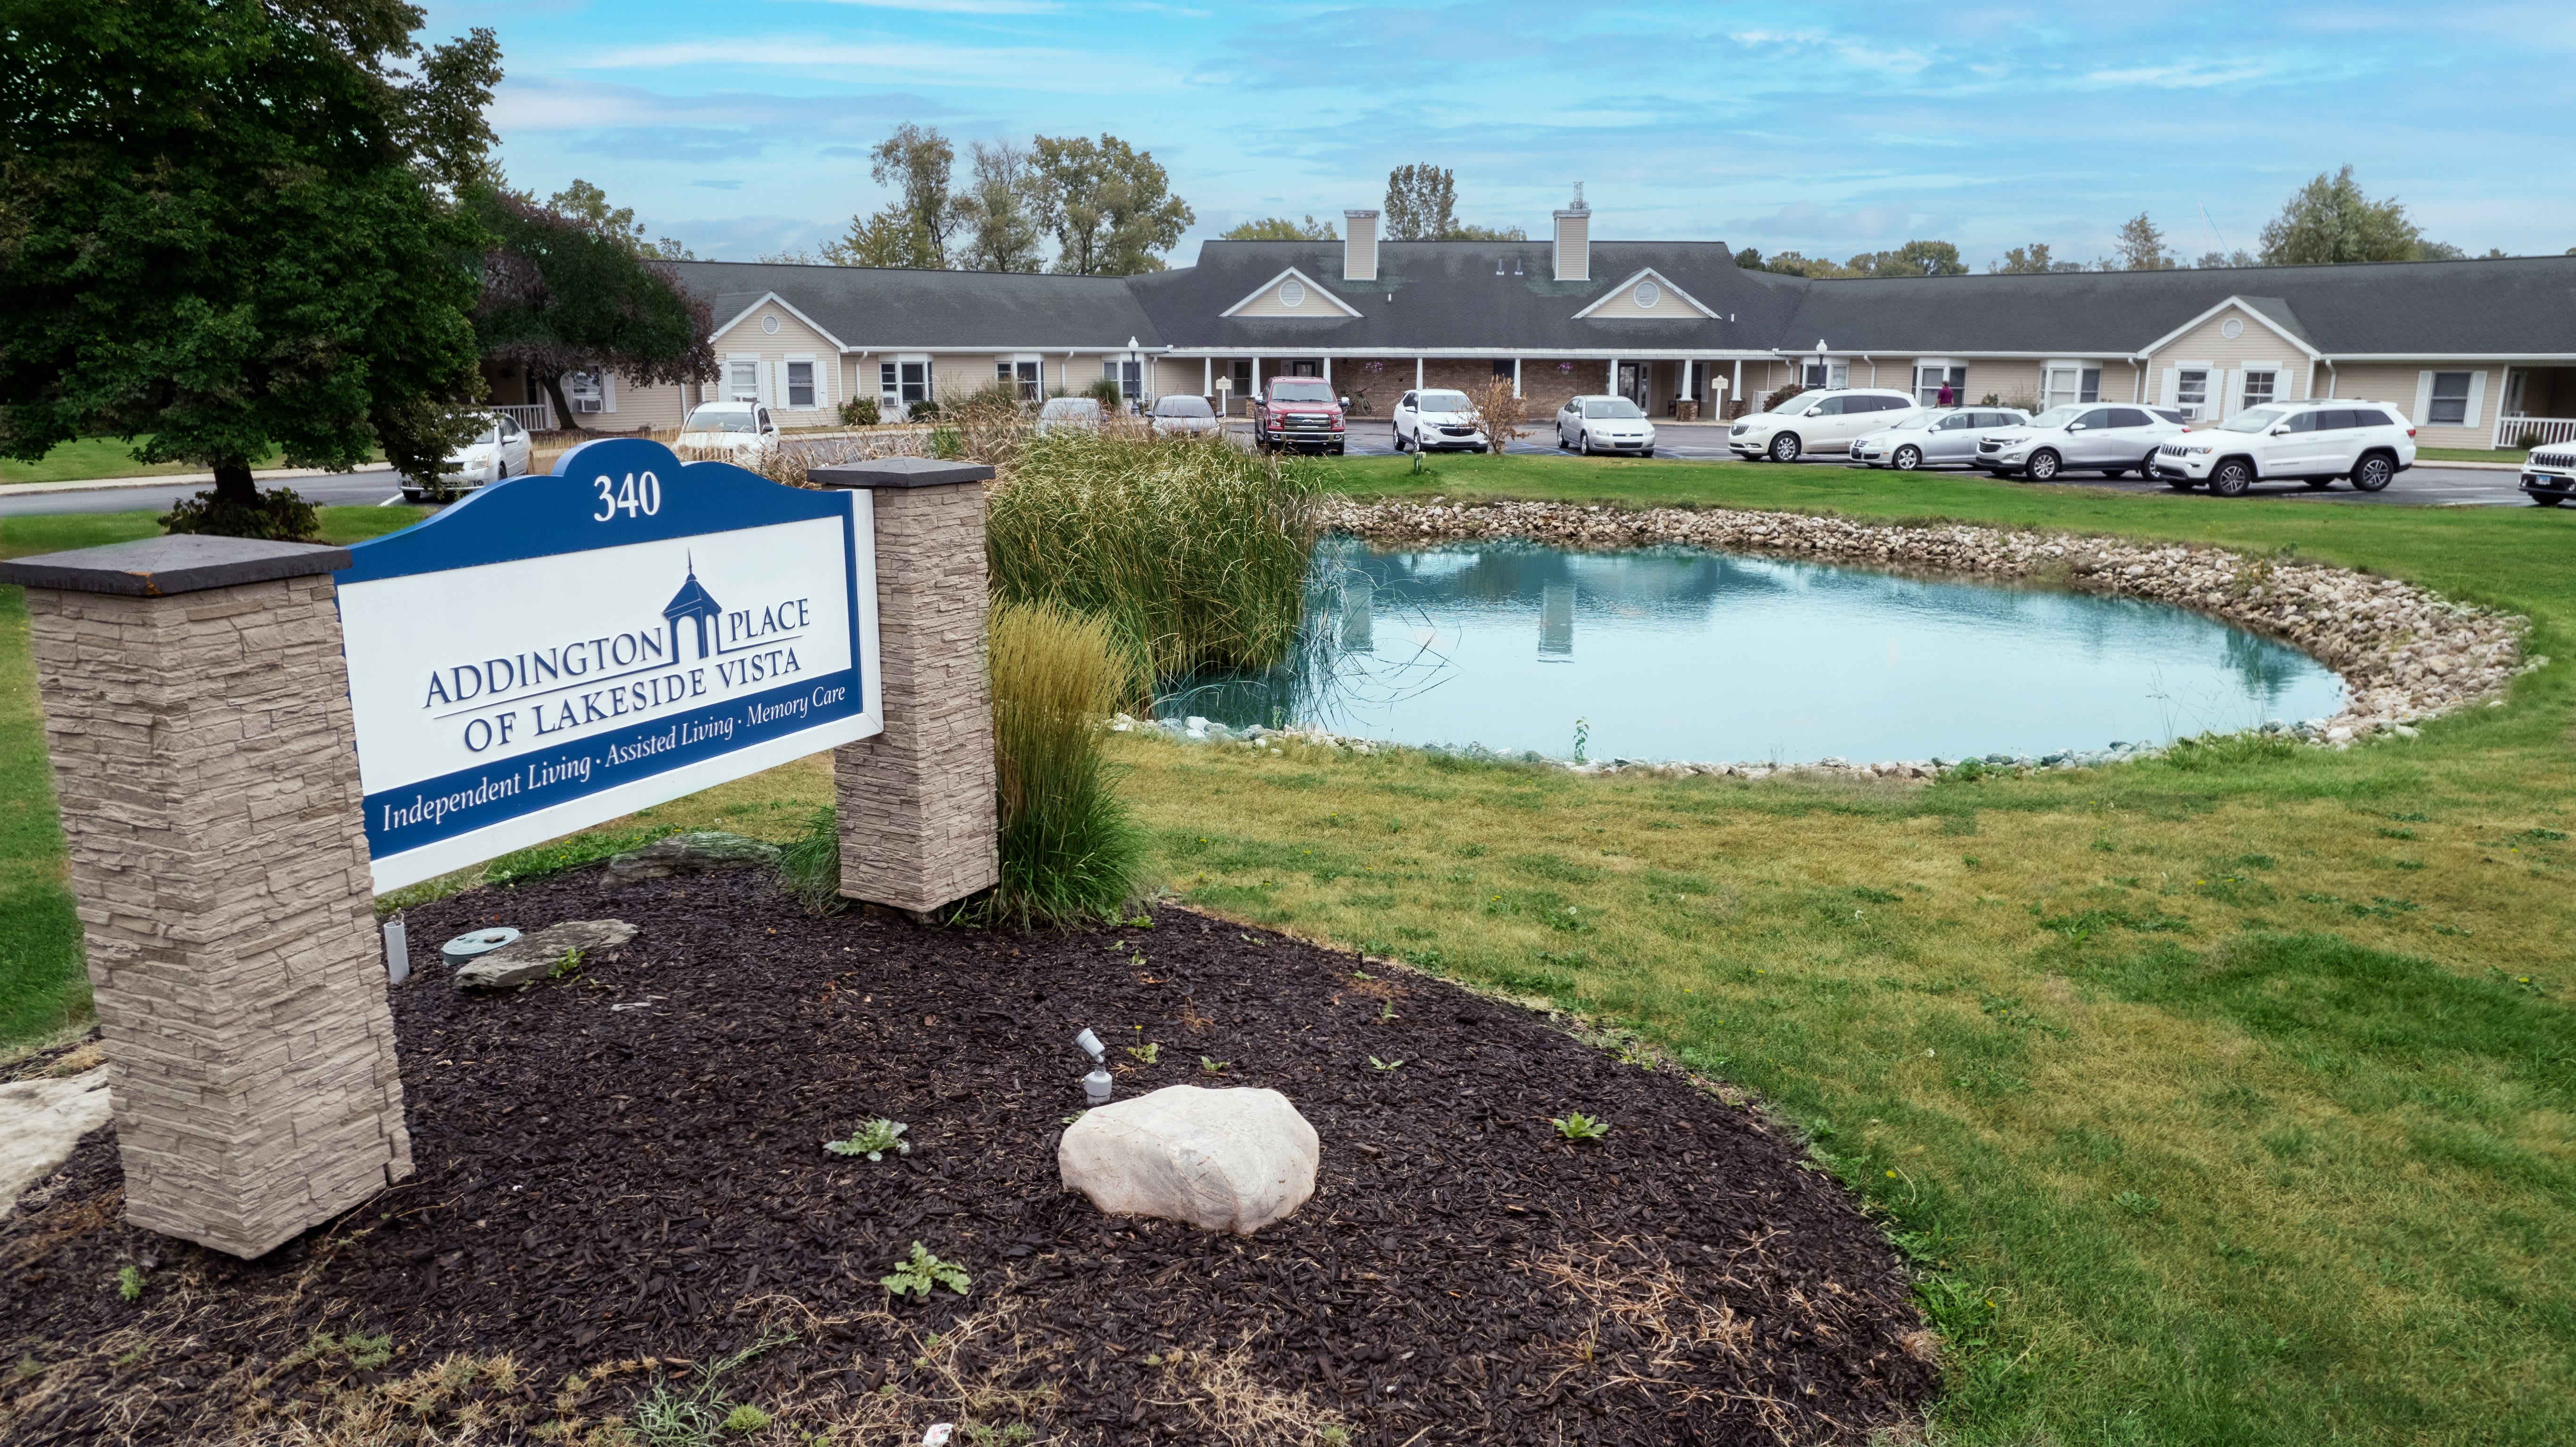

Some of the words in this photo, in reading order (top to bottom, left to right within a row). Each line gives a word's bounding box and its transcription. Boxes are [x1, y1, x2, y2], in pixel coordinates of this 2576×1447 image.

[594, 470, 661, 522] 340
[422, 626, 662, 709] ADDINGTON
[728, 597, 810, 642] PLACE
[463, 711, 517, 753] OF
[530, 667, 707, 737] LAKESIDE
[714, 646, 801, 689] VISTA
[383, 773, 520, 831] Independent
[528, 756, 590, 789] Living
[607, 725, 676, 765] Assisted
[681, 717, 733, 745] Living
[748, 696, 808, 725] Memory
[812, 686, 845, 707] Care
